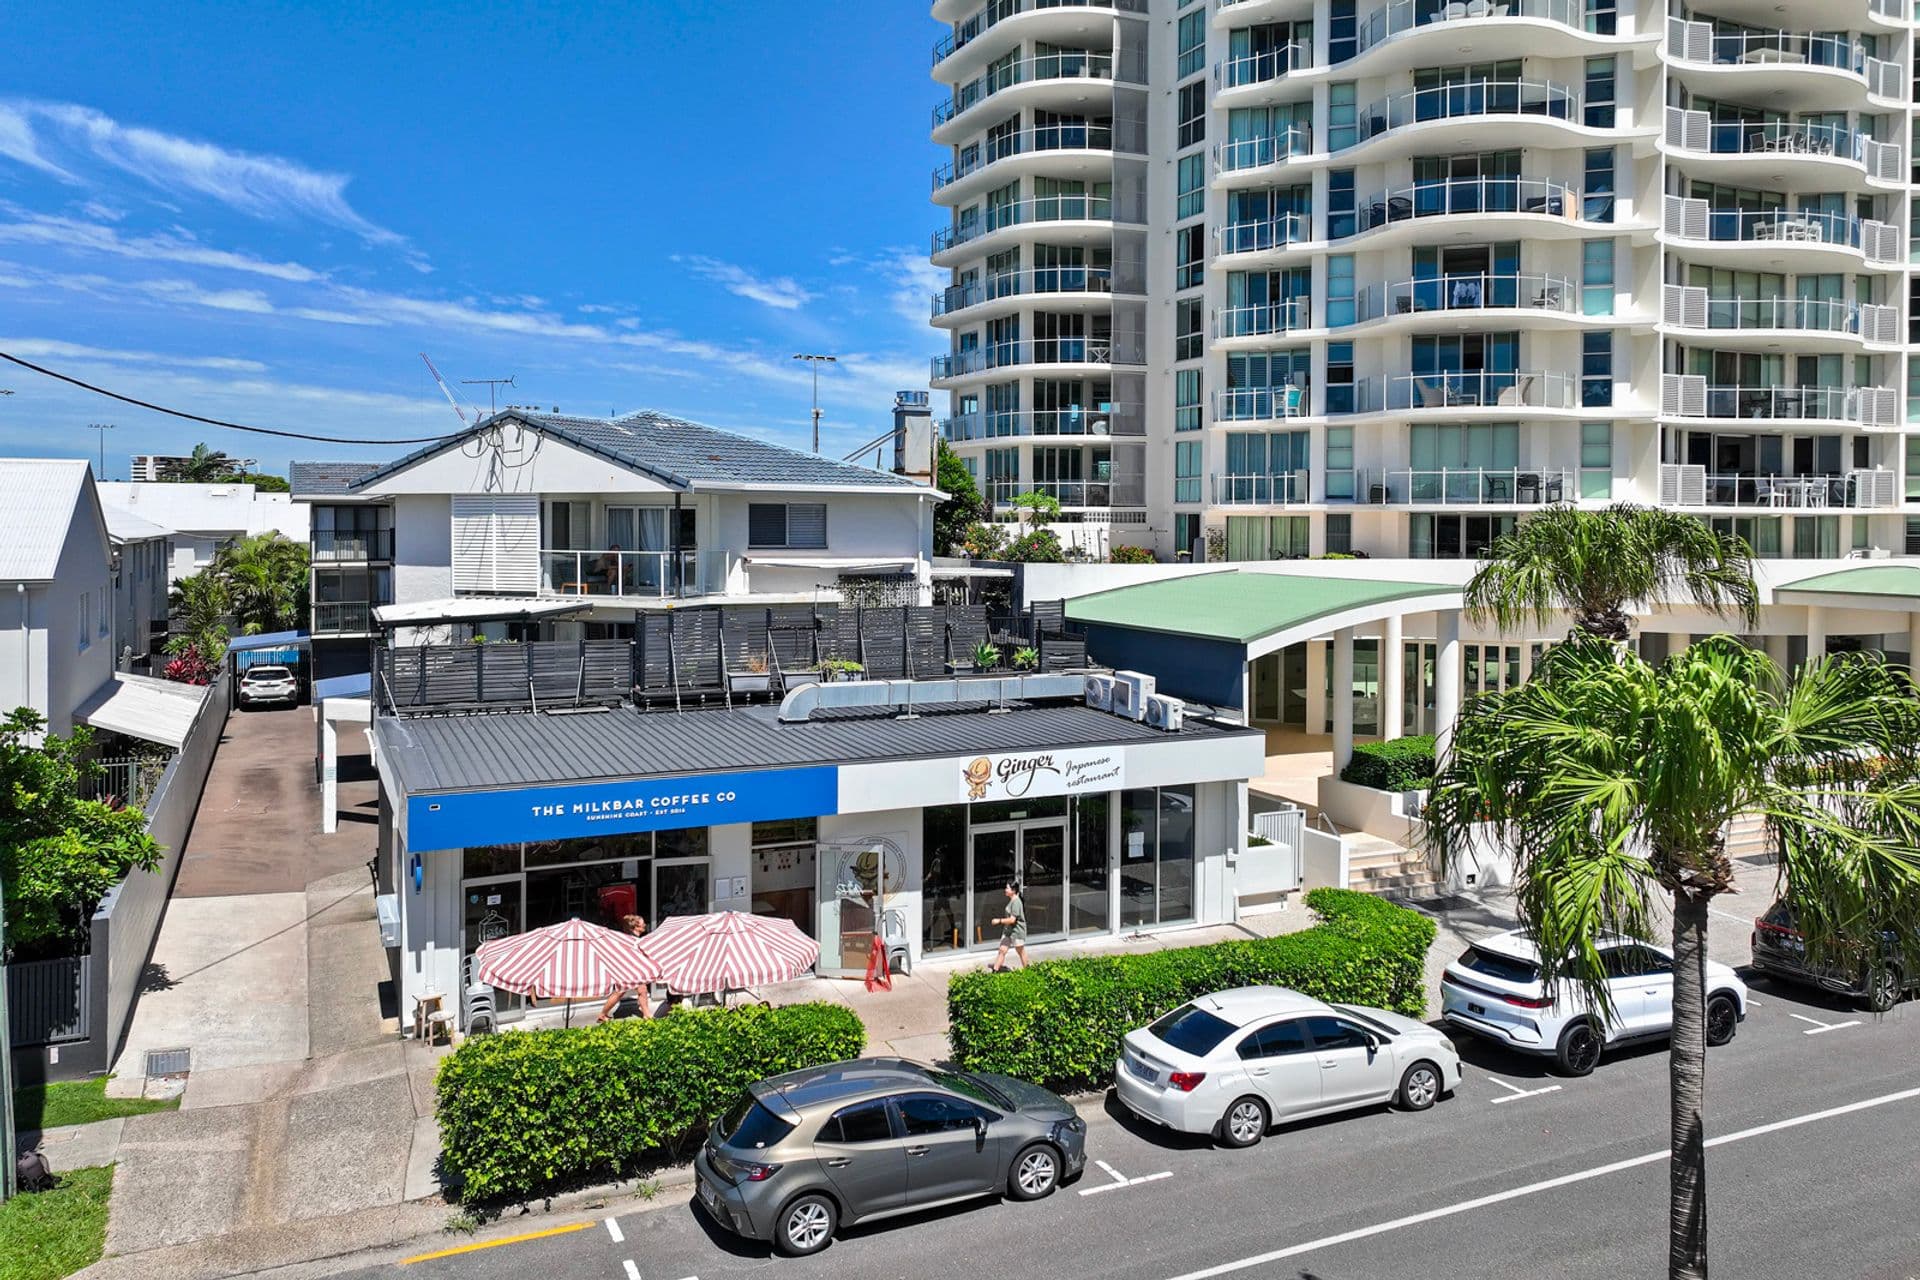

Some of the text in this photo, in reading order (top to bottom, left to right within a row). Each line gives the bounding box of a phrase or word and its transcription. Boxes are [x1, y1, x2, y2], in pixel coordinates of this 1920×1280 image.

[996, 753, 1060, 797] Ginger
[1065, 756, 1111, 777] Japanese
[1066, 766, 1120, 788] restaurant
[531, 791, 736, 817] THE MILKBAR COFFEE CO
